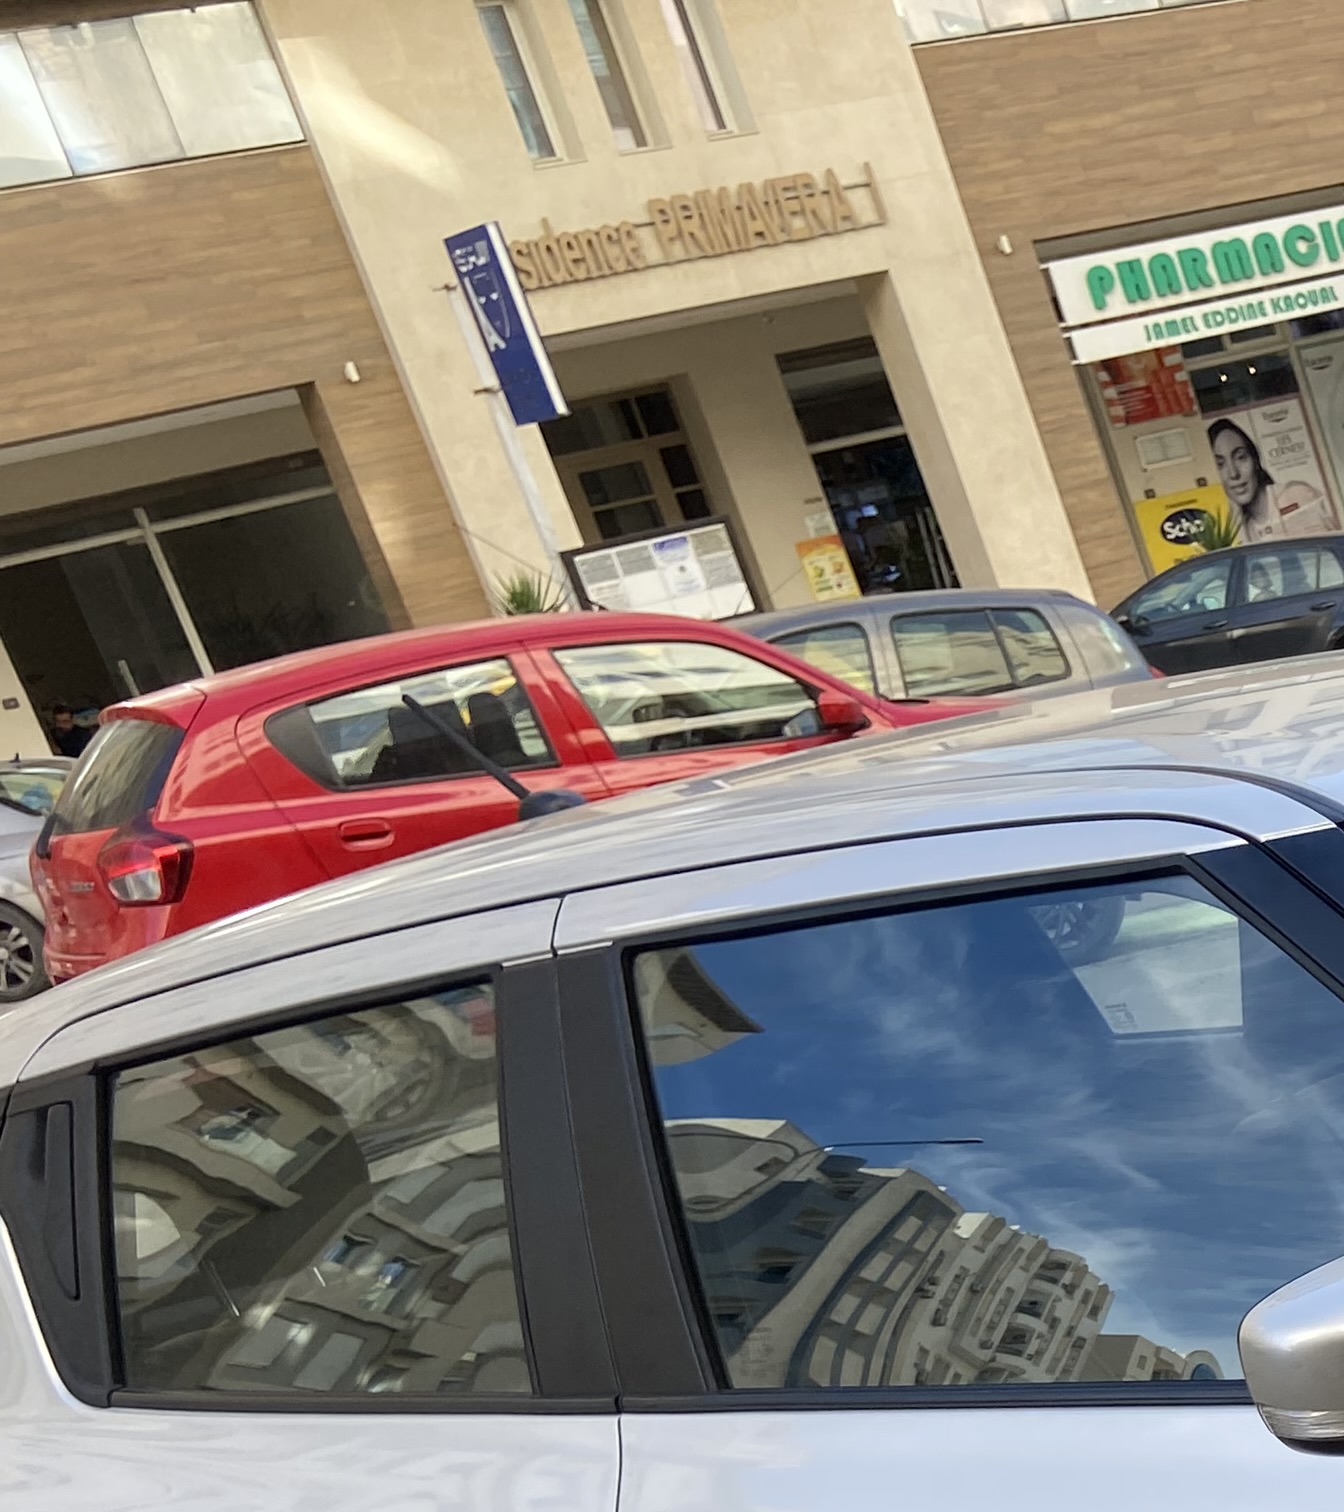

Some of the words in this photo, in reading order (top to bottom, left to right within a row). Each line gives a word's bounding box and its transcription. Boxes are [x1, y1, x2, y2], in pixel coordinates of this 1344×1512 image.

[510, 216, 647, 291] sidence
[647, 167, 858, 264] PRIMAVERA
[1143, 315, 1199, 343] JAMEL
[1203, 302, 1269, 331] EDDINE
[1163, 512, 1206, 542] Scho
